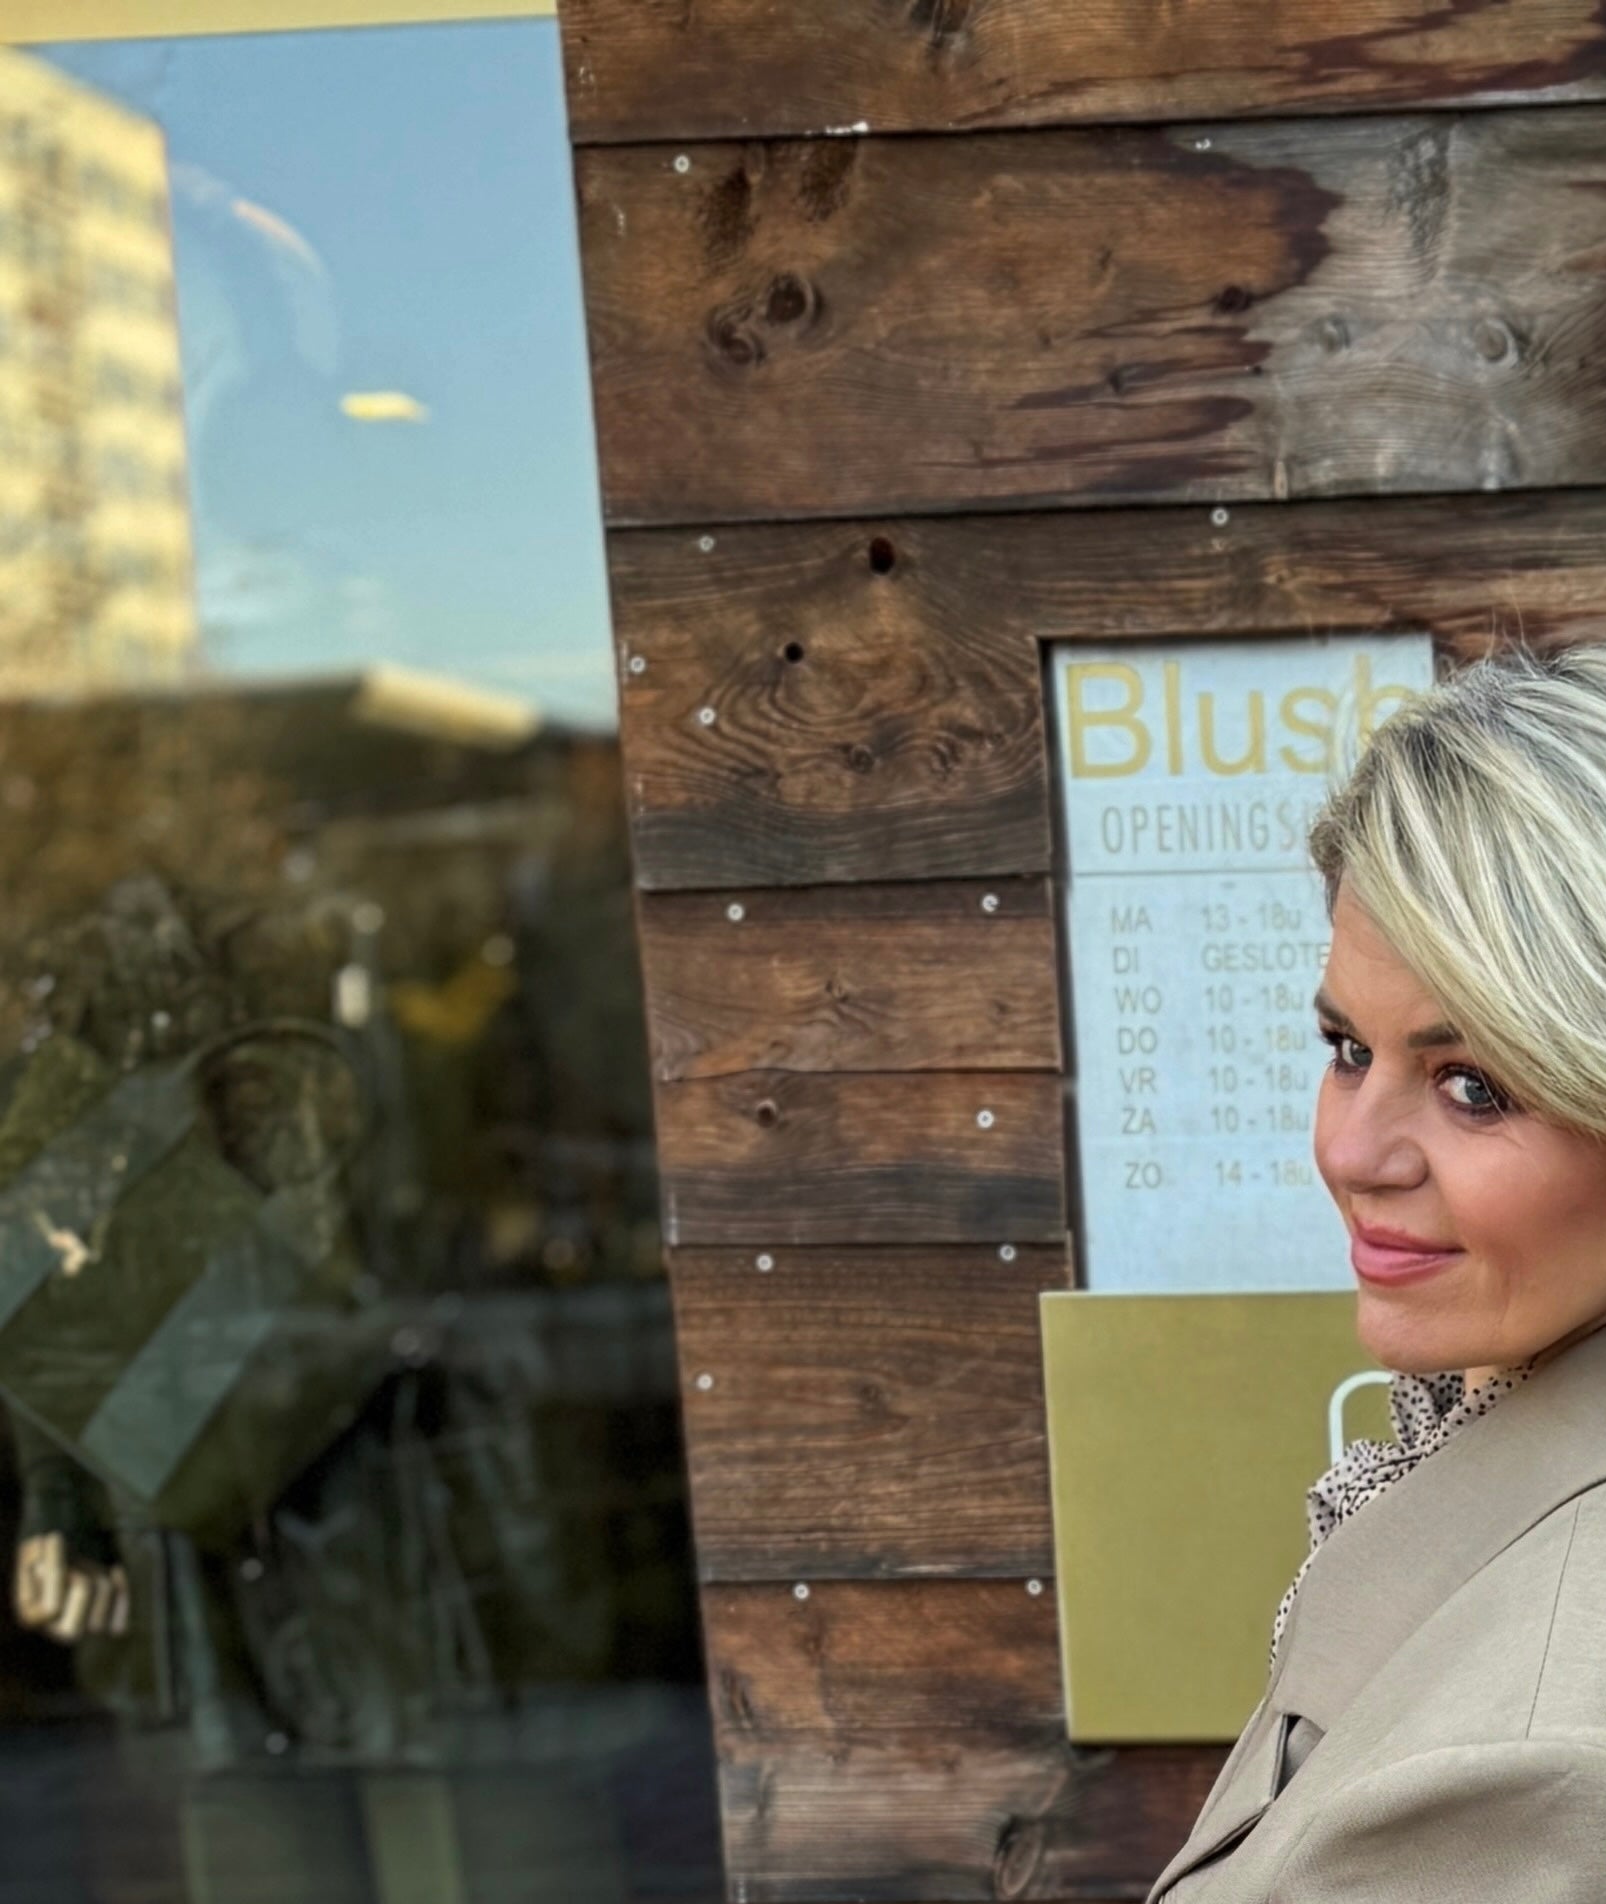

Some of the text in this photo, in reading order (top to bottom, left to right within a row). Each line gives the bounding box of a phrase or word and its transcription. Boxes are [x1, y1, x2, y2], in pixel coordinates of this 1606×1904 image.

[1101, 802, 1312, 855] OPENINGS
[1110, 904, 1153, 934] MA
[1201, 903, 1231, 933] 13
[1258, 901, 1301, 931] 18u
[1113, 940, 1330, 974] DI GESLOTE
[1114, 985, 1162, 1015] WO
[1204, 983, 1233, 1013] 10
[1260, 981, 1304, 1011] 18u
[1118, 1025, 1158, 1055] DO
[1206, 1024, 1236, 1054] 10
[1264, 1024, 1307, 1052] 18u
[1118, 1066, 1157, 1095] VR
[1207, 1064, 1238, 1094] 10
[1263, 1063, 1309, 1093] 18u
[1121, 1104, 1157, 1135] ZA
[1210, 1104, 1240, 1134] 10
[1266, 1103, 1310, 1133] 18u
[1124, 1161, 1162, 1190] ZO
[1214, 1159, 1242, 1186] 14
